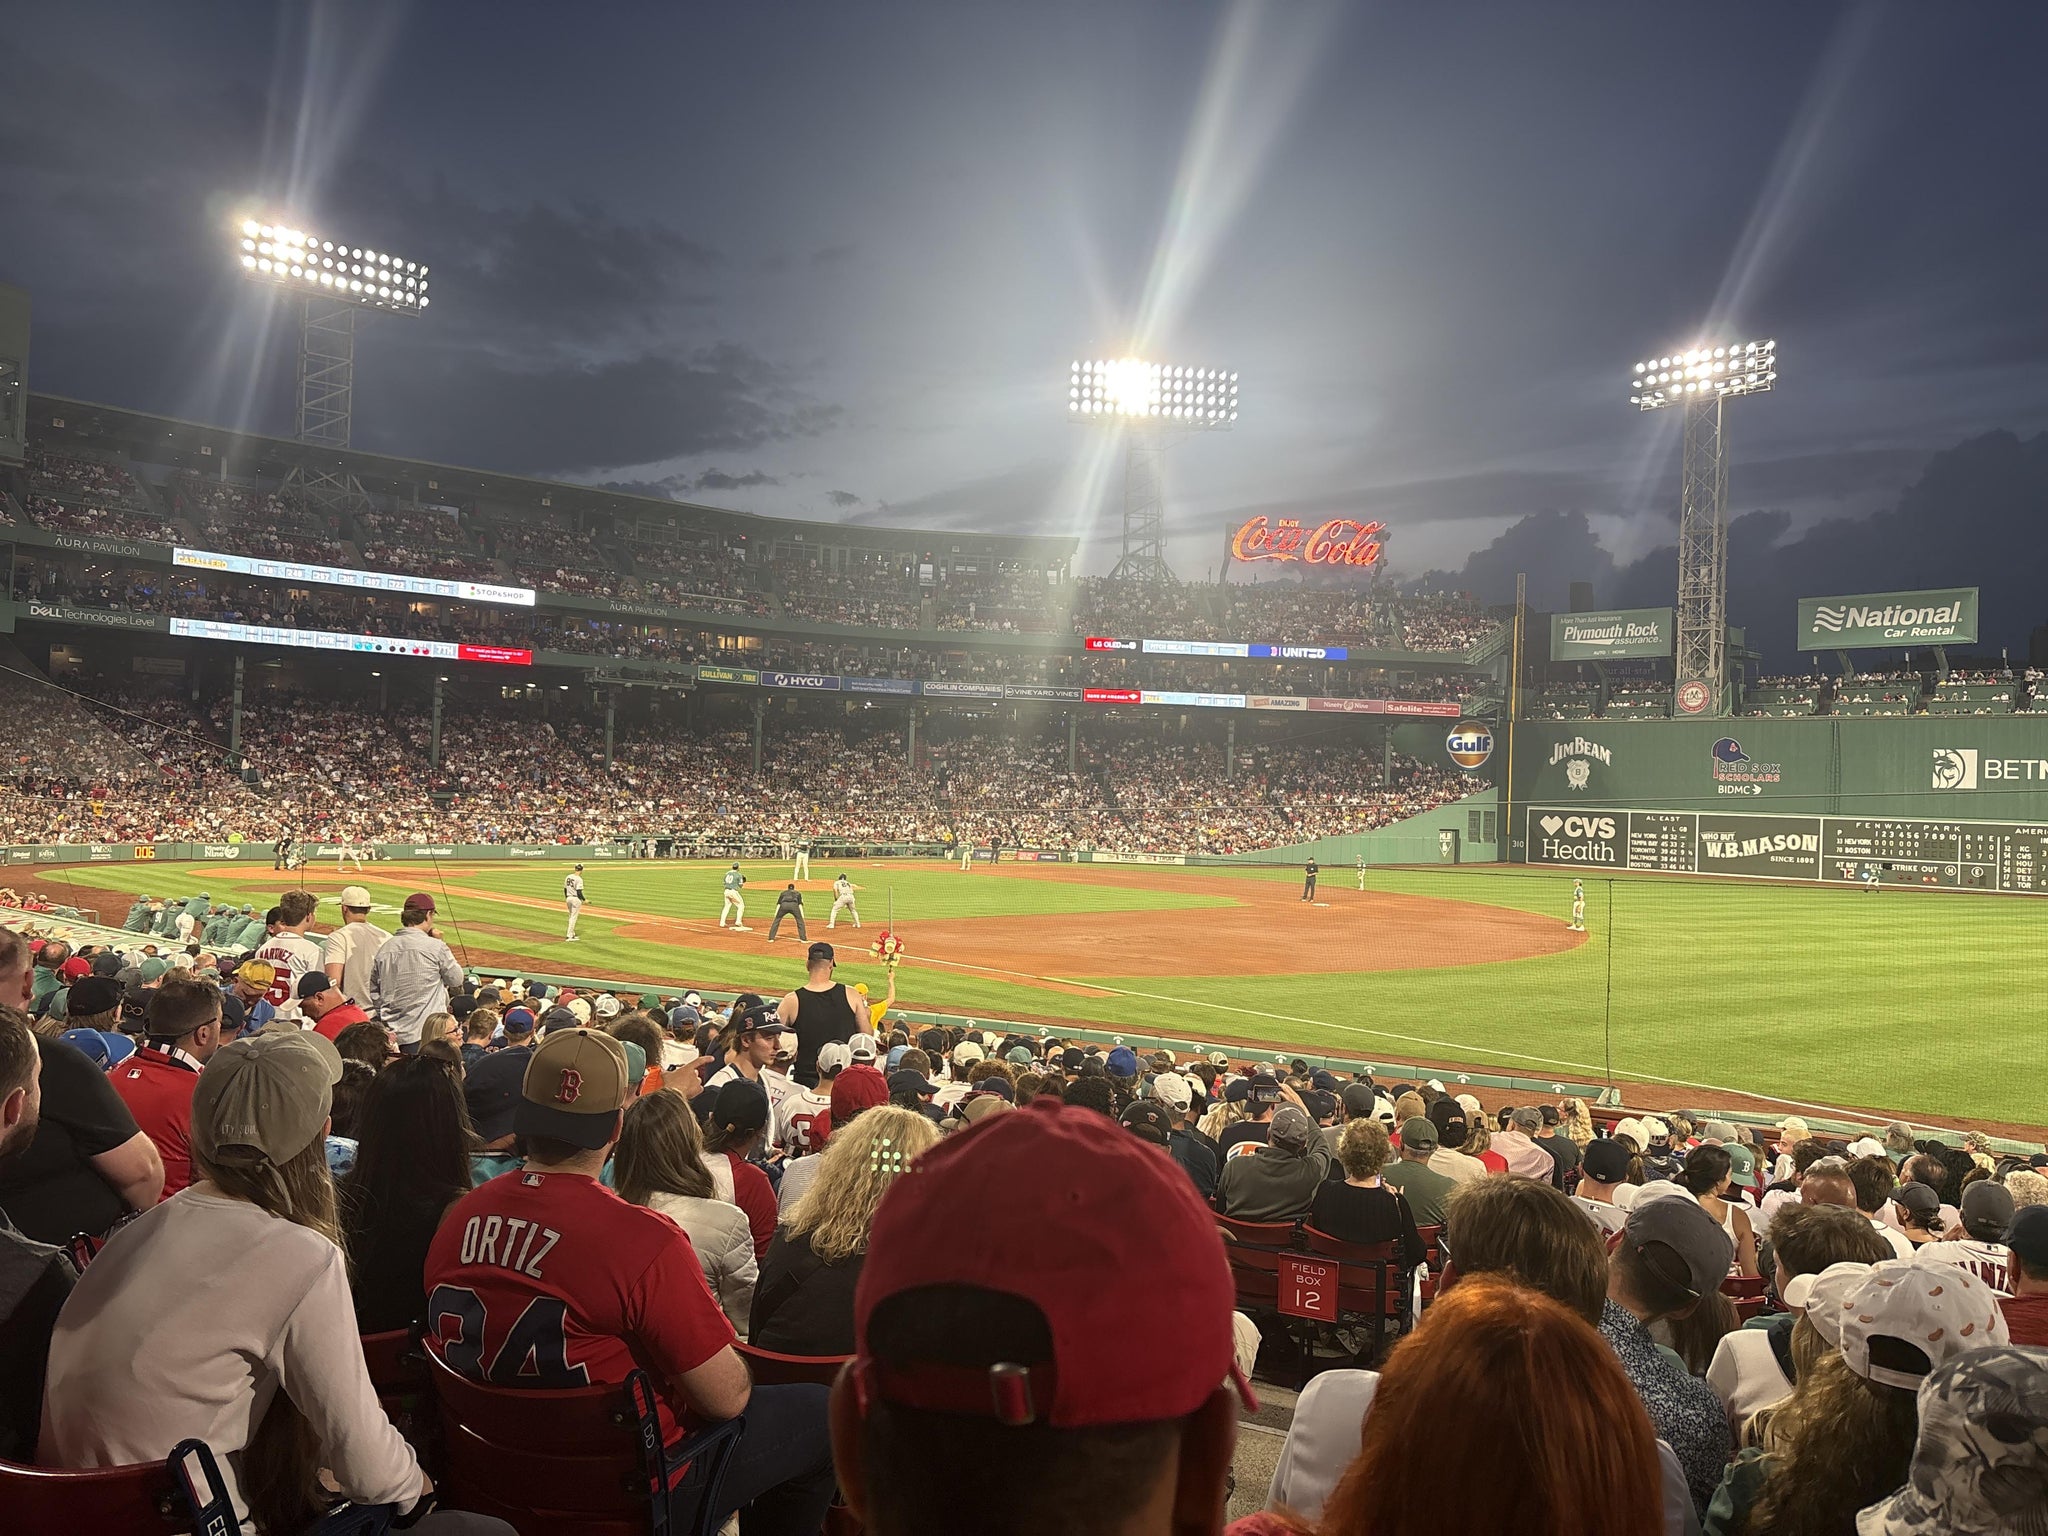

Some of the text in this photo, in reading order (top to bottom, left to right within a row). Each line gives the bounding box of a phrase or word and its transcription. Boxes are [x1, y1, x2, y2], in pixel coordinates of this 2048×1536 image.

[1232, 516, 1386, 566] Coca-Cola
[93, 542, 140, 556] PAVILION
[30, 606, 155, 626] DELL Technologies Level
[634, 606, 668, 616] PAVILION
[1846, 601, 1961, 628] National
[1564, 622, 1659, 641] Plymouth Rock
[1884, 626, 1954, 638] Car Rental
[1282, 648, 1326, 658] UNITED
[700, 670, 756, 682] SULLIVAN TIRE
[790, 676, 823, 686] HYCU
[926, 683, 1002, 693] COGHLIN COMPANIES
[1014, 688, 1054, 696] VINEYARD
[1324, 701, 1342, 709] Ninety
[1388, 704, 1422, 712] Safelite
[1448, 736, 1492, 752] Gulf
[1549, 736, 1612, 766] JIM BEAM
[1719, 763, 1781, 774] RED SOX
[1718, 773, 1781, 782] SCHOLARS
[1718, 785, 1750, 794] BIDMC
[1564, 816, 1616, 839] CVS
[1512, 840, 1524, 848] 310
[1542, 838, 1616, 862] Health
[134, 846, 156, 859] 006
[554, 1068, 584, 1104] B
[1742, 1160, 1751, 1172] B
[460, 1215, 561, 1278] ORTIZ
[1291, 1262, 1326, 1276] FIELD
[1296, 1274, 1321, 1286] BOX
[1296, 1288, 1320, 1310] 12
